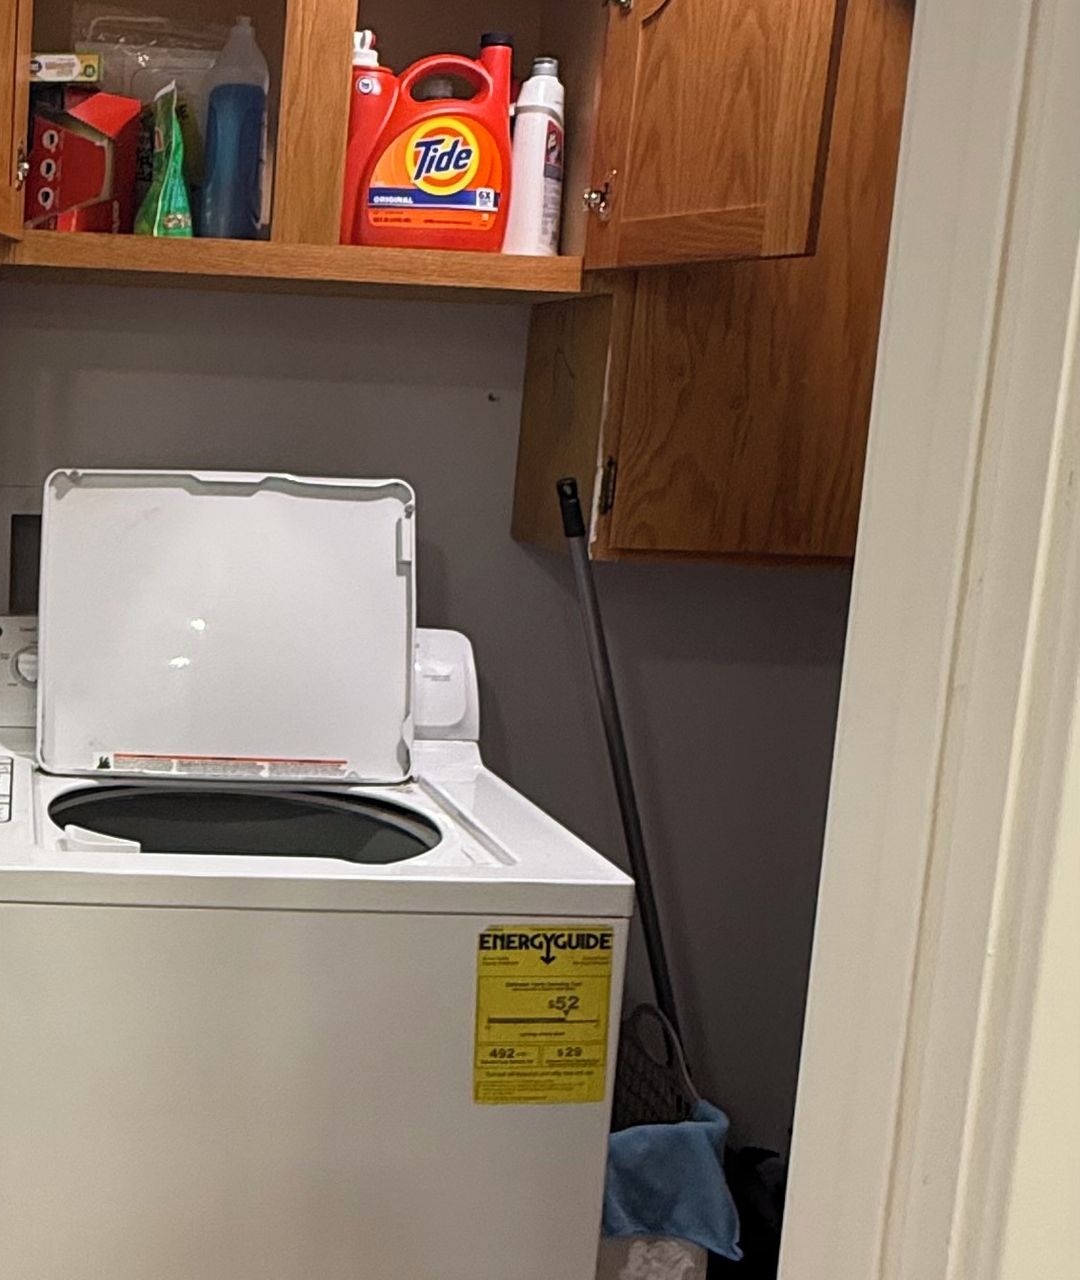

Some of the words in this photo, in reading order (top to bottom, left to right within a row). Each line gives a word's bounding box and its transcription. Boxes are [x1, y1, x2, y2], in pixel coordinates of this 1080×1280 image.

[413, 138, 473, 181] Tide
[372, 195, 414, 205] ORIGINAL
[479, 933, 613, 951] ENERGYGUIDE
[548, 995, 580, 1011] $52
